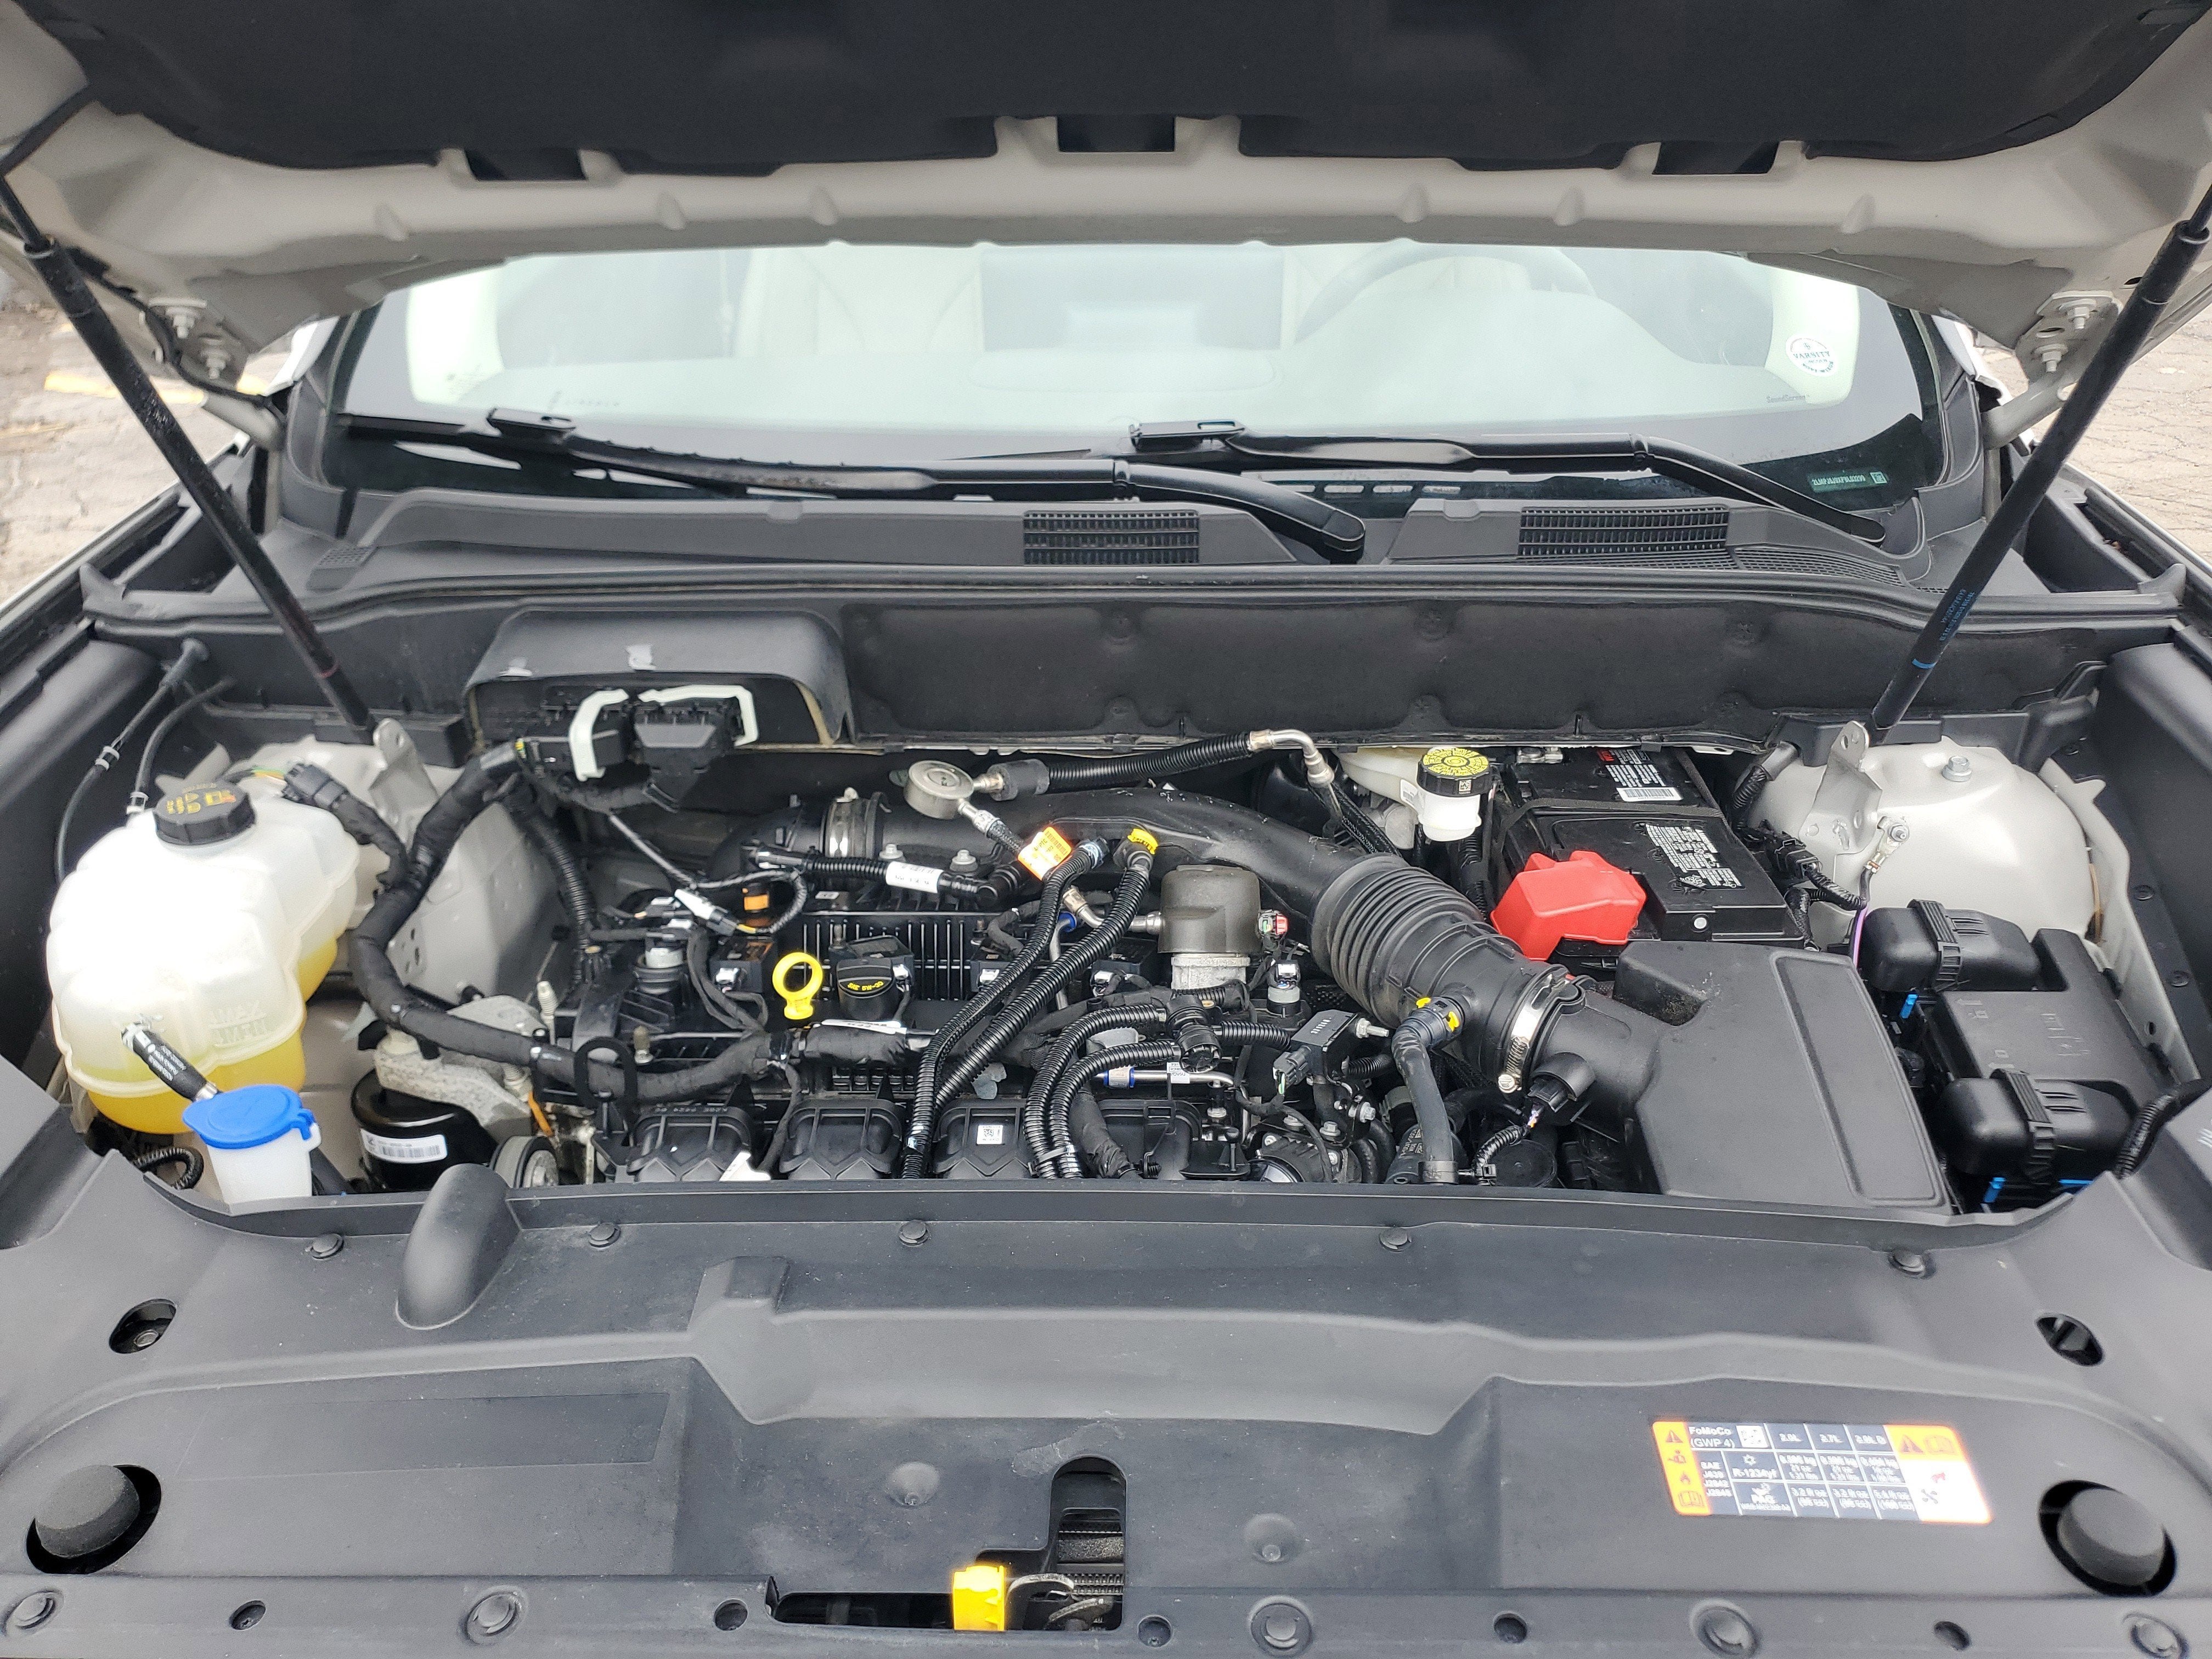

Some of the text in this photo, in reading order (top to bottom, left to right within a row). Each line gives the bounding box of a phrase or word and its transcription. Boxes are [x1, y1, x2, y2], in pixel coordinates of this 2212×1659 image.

[1688, 1426, 1732, 1435] FoMoCo
[1690, 1438, 1735, 1448] (GWP 4)
[1732, 1468, 1778, 1479] R-1234yf
